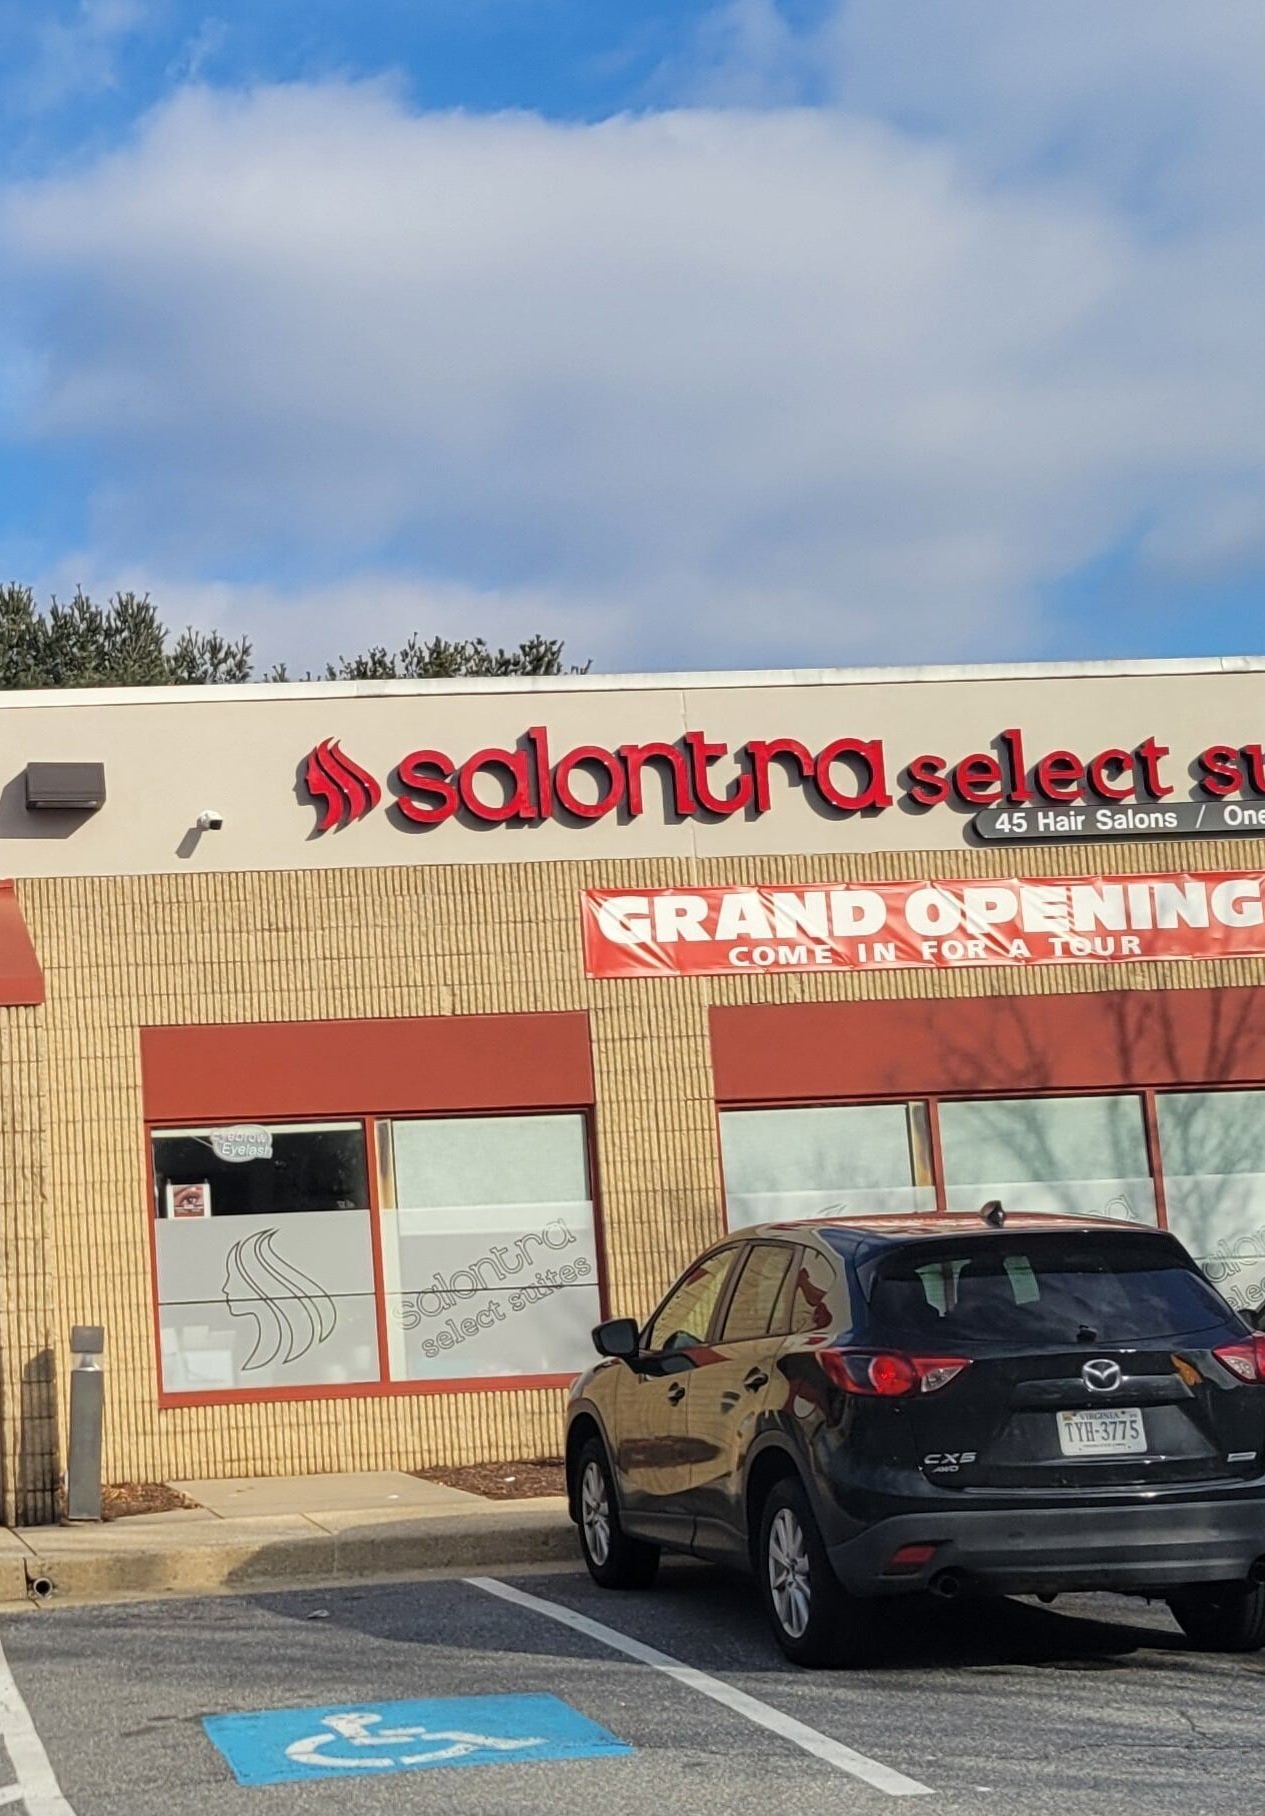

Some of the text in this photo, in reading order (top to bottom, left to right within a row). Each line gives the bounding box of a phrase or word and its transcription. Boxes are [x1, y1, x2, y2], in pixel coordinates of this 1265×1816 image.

[397, 725, 894, 824] salontra
[907, 728, 1175, 806] select
[994, 812, 1029, 834] 45
[1037, 810, 1086, 833] Hair
[1095, 808, 1179, 831] Salons
[1223, 804, 1265, 827] One
[596, 879, 1265, 944] GRAND OPENING
[728, 935, 1143, 967] COME IN FOR A TOUR
[222, 1142, 273, 1159] Eyelash
[393, 1217, 577, 1331] salontra
[421, 1256, 592, 1359] select suites
[1064, 1419, 1140, 1443] TYH-3775
